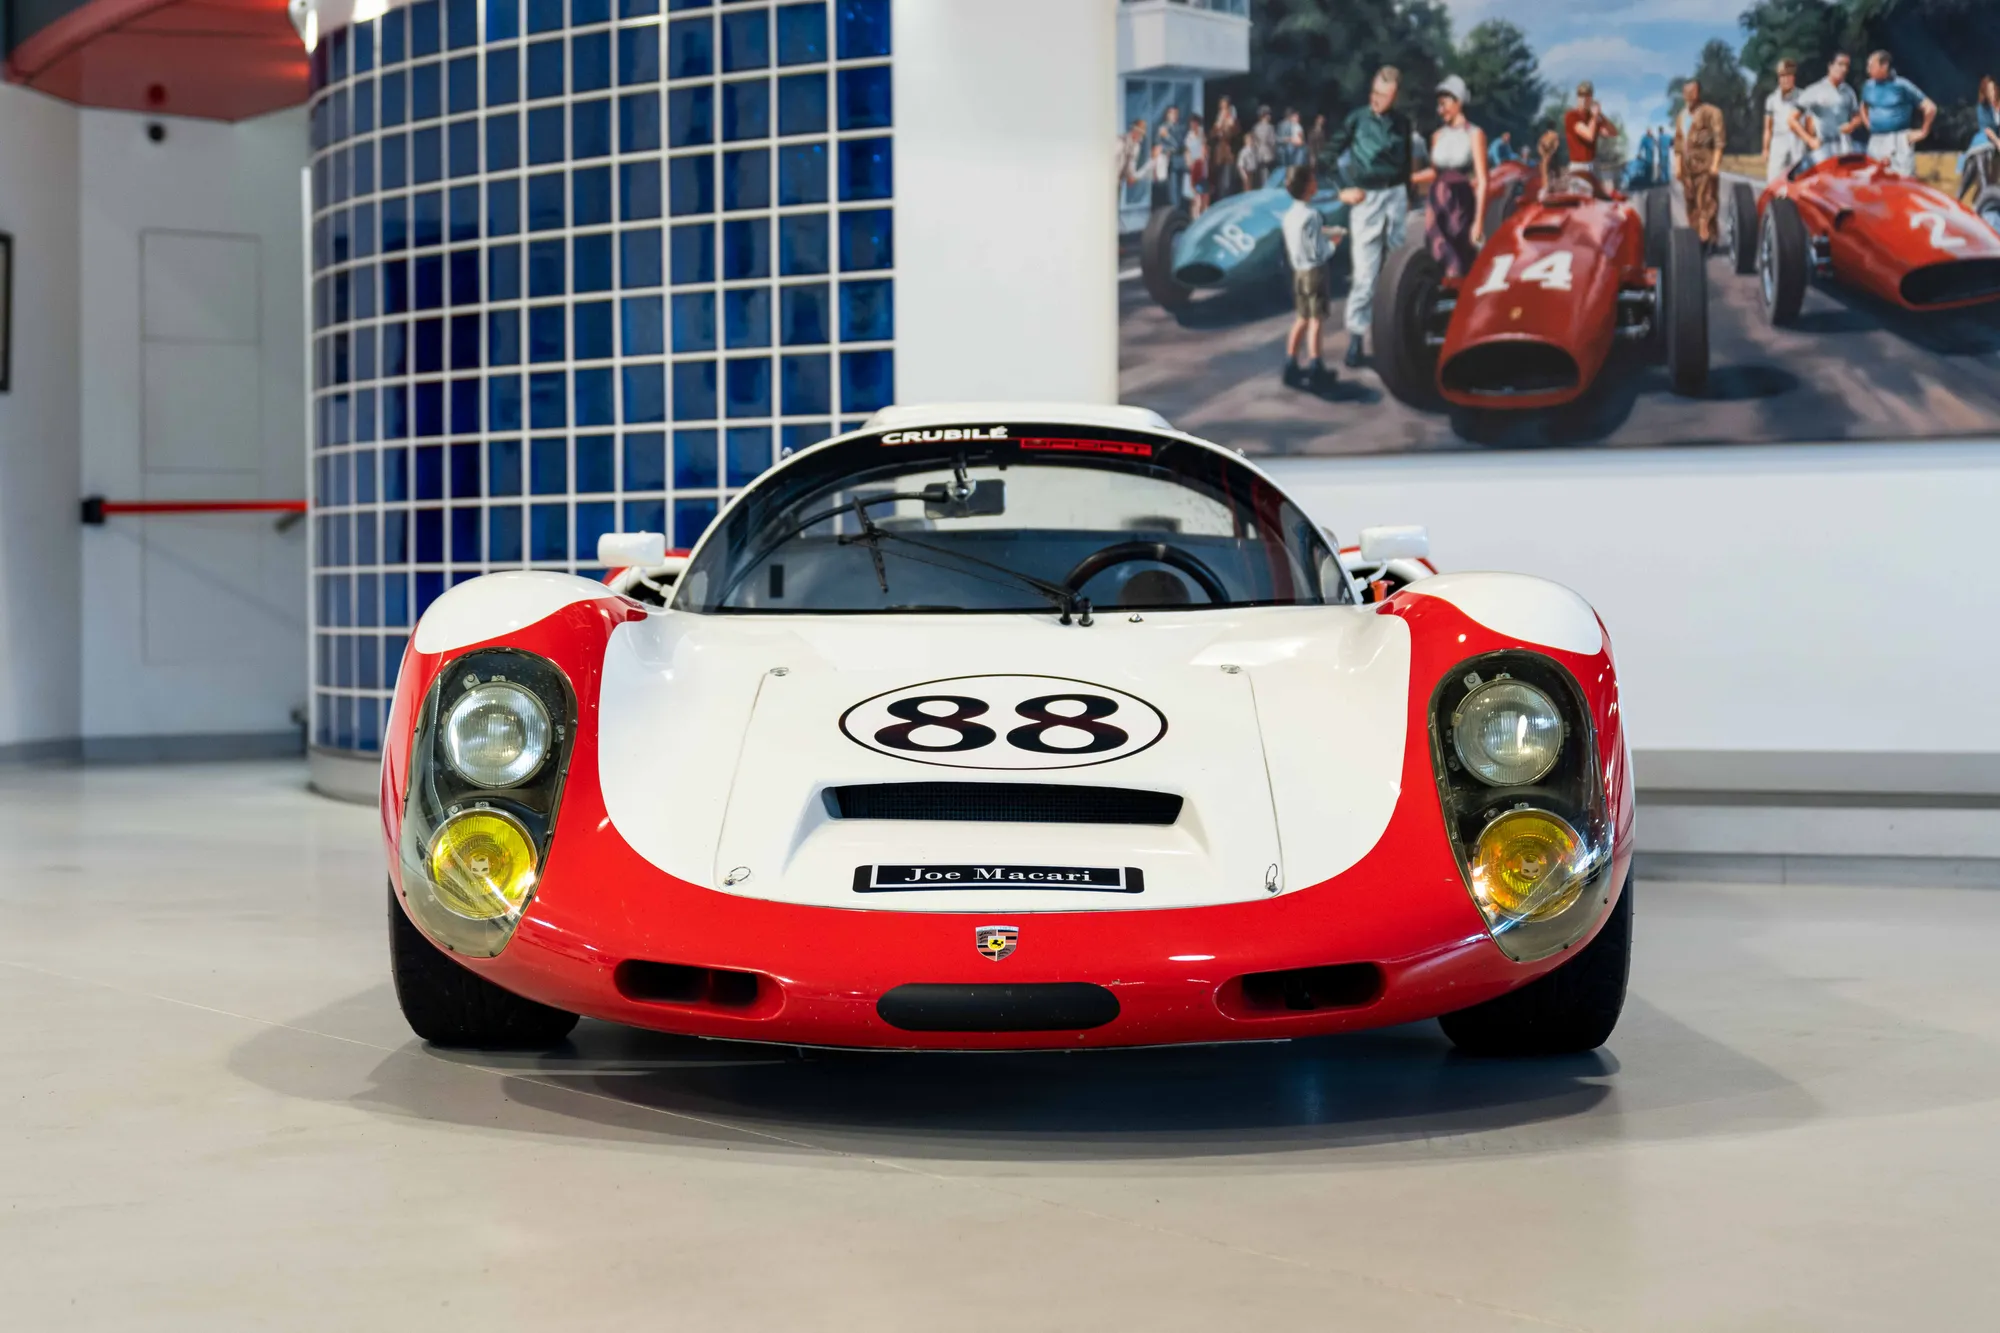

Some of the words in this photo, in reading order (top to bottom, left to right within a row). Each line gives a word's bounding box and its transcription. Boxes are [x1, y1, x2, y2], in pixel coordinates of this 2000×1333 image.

[1213, 223, 1256, 257] 18
[1909, 212, 1966, 248] 2
[1474, 250, 1573, 296] 14
[881, 426, 1008, 445] CRUBILÉ
[874, 694, 1129, 754] 88
[904, 867, 961, 882] Joe
[973, 867, 1093, 883] Macari
